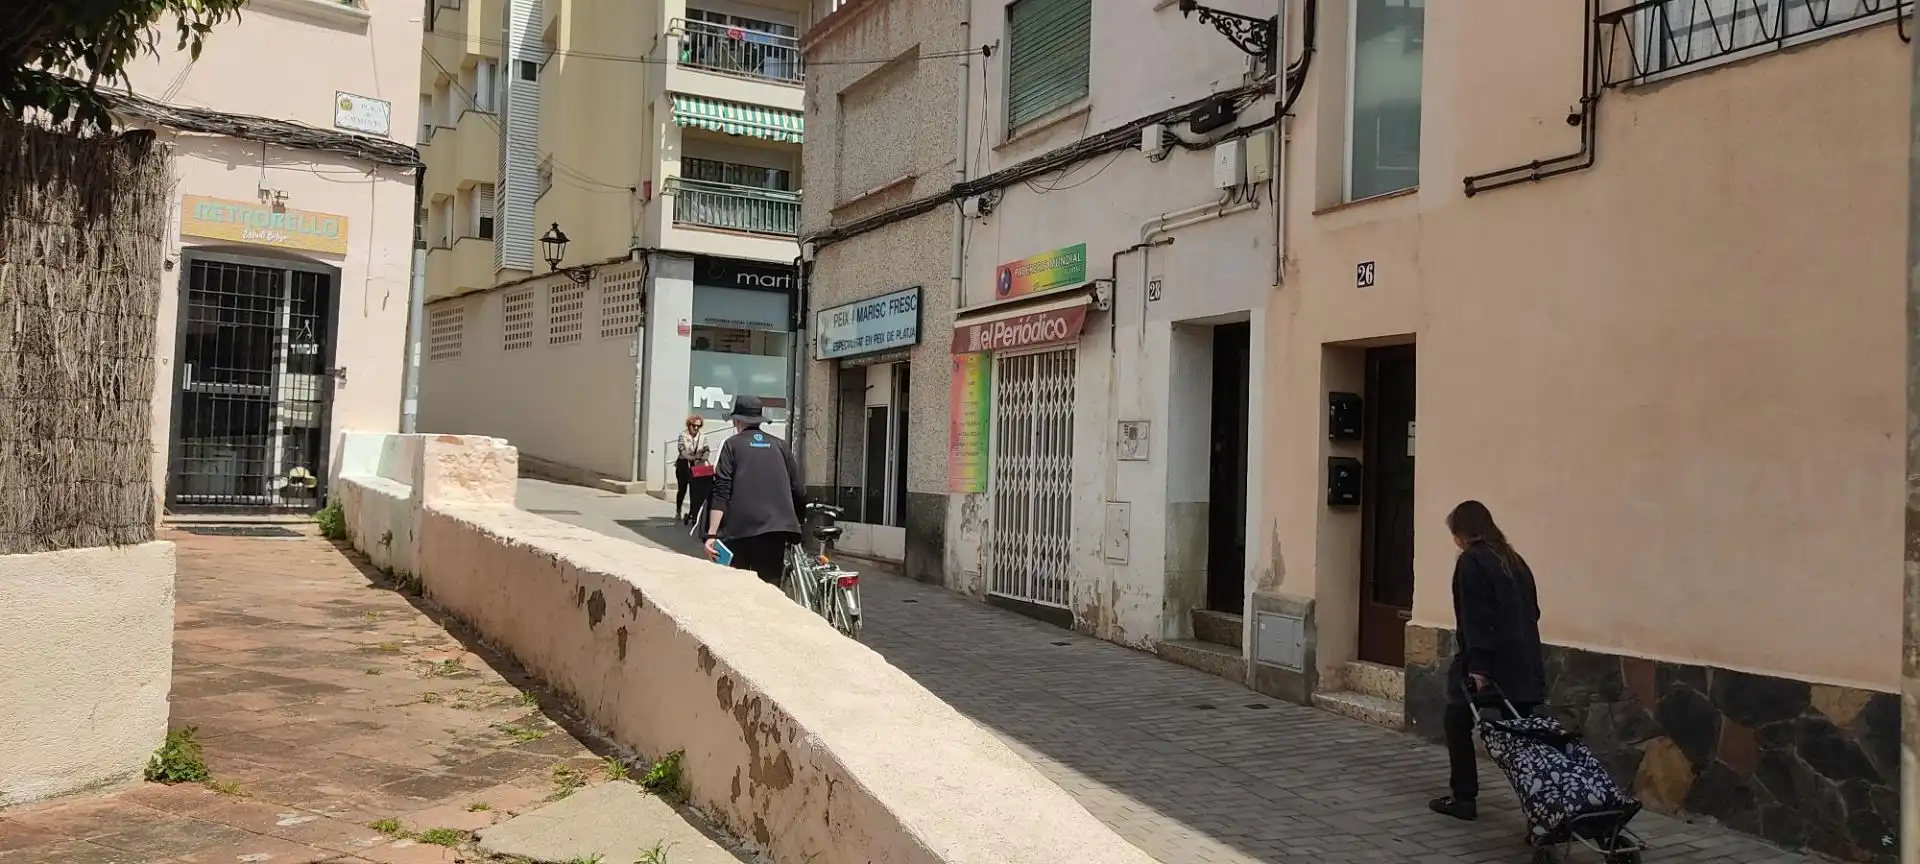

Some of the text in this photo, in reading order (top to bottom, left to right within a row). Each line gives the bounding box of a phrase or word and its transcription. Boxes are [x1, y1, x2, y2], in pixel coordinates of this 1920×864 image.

[194, 201, 339, 239] RETROBELLO
[1358, 264, 1373, 286] 26
[1150, 281, 1161, 300] 28
[833, 310, 850, 328] PEIX
[856, 302, 887, 323] MARISC
[889, 294, 917, 316] FRESC
[874, 332, 885, 345] PEIX
[887, 331, 894, 342] DE
[896, 326, 916, 340] PLATJA
